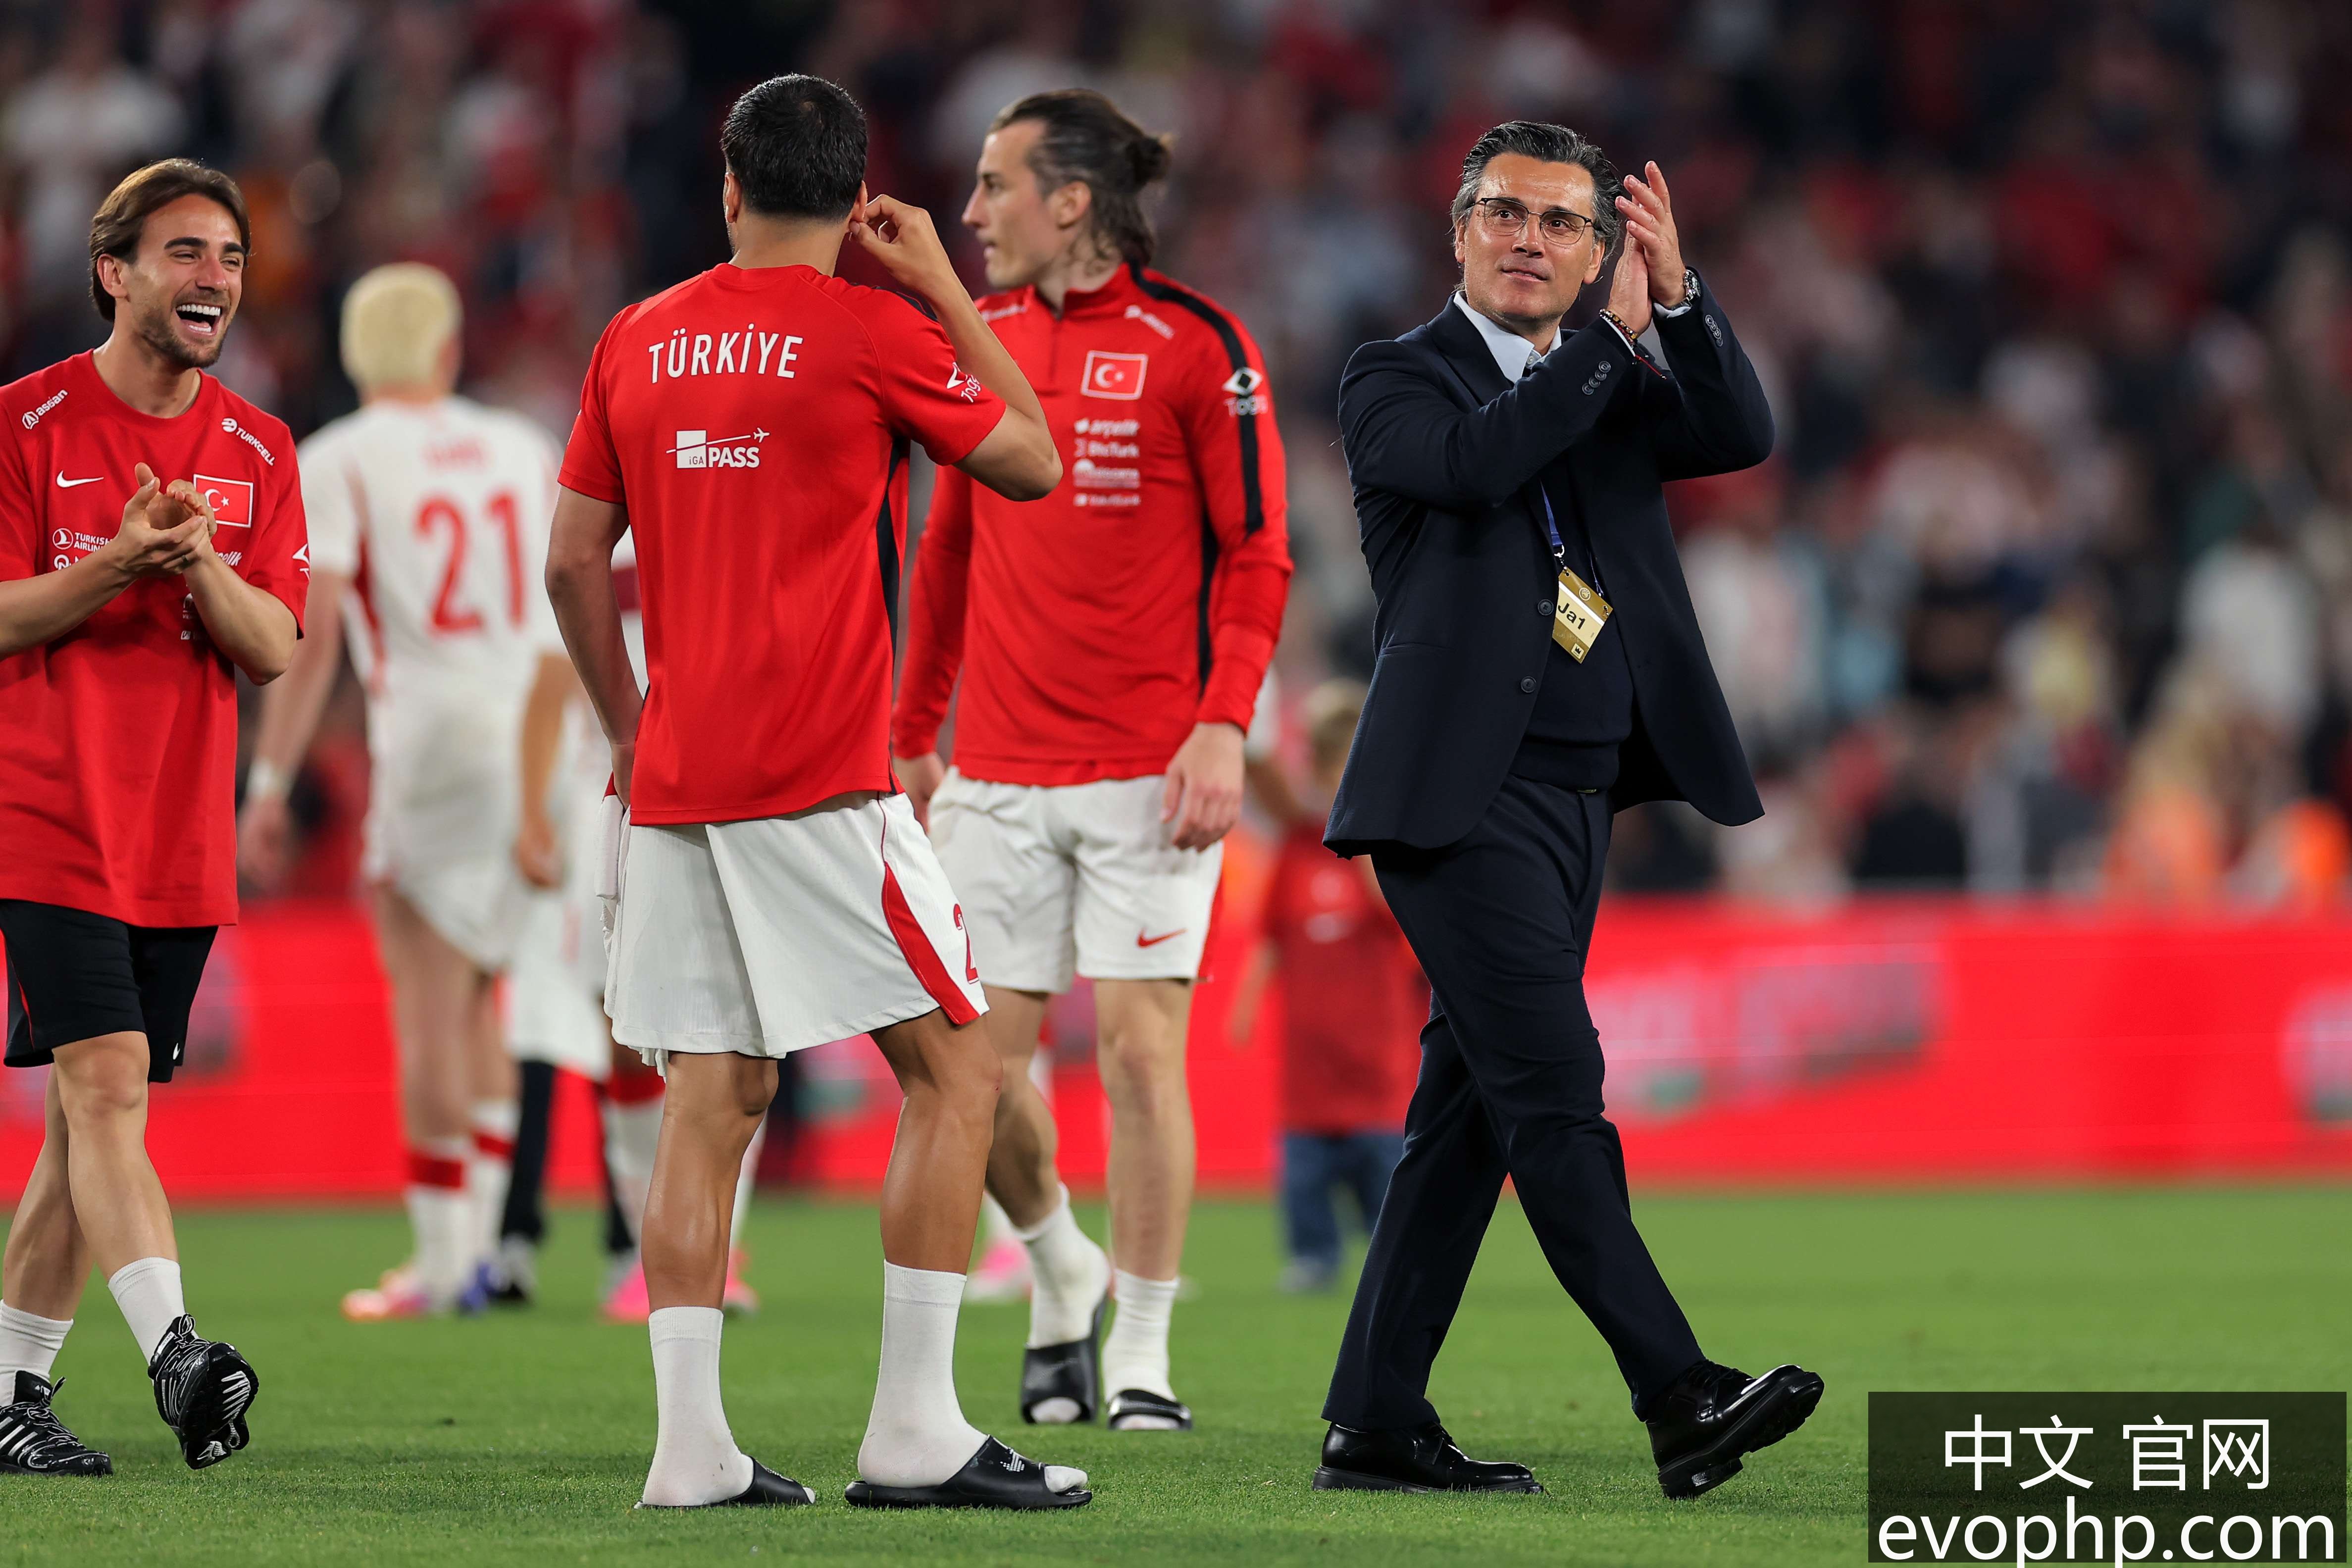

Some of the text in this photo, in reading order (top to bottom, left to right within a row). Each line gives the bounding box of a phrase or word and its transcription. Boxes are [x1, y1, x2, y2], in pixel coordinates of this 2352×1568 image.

[648, 323, 803, 384] TÜRKİYE
[236, 427, 275, 466] TURKCELL
[708, 447, 760, 468] PASS
[74, 541, 103, 552] AIRLIN
[415, 491, 525, 635] 21
[1558, 603, 1586, 630] Ja1
